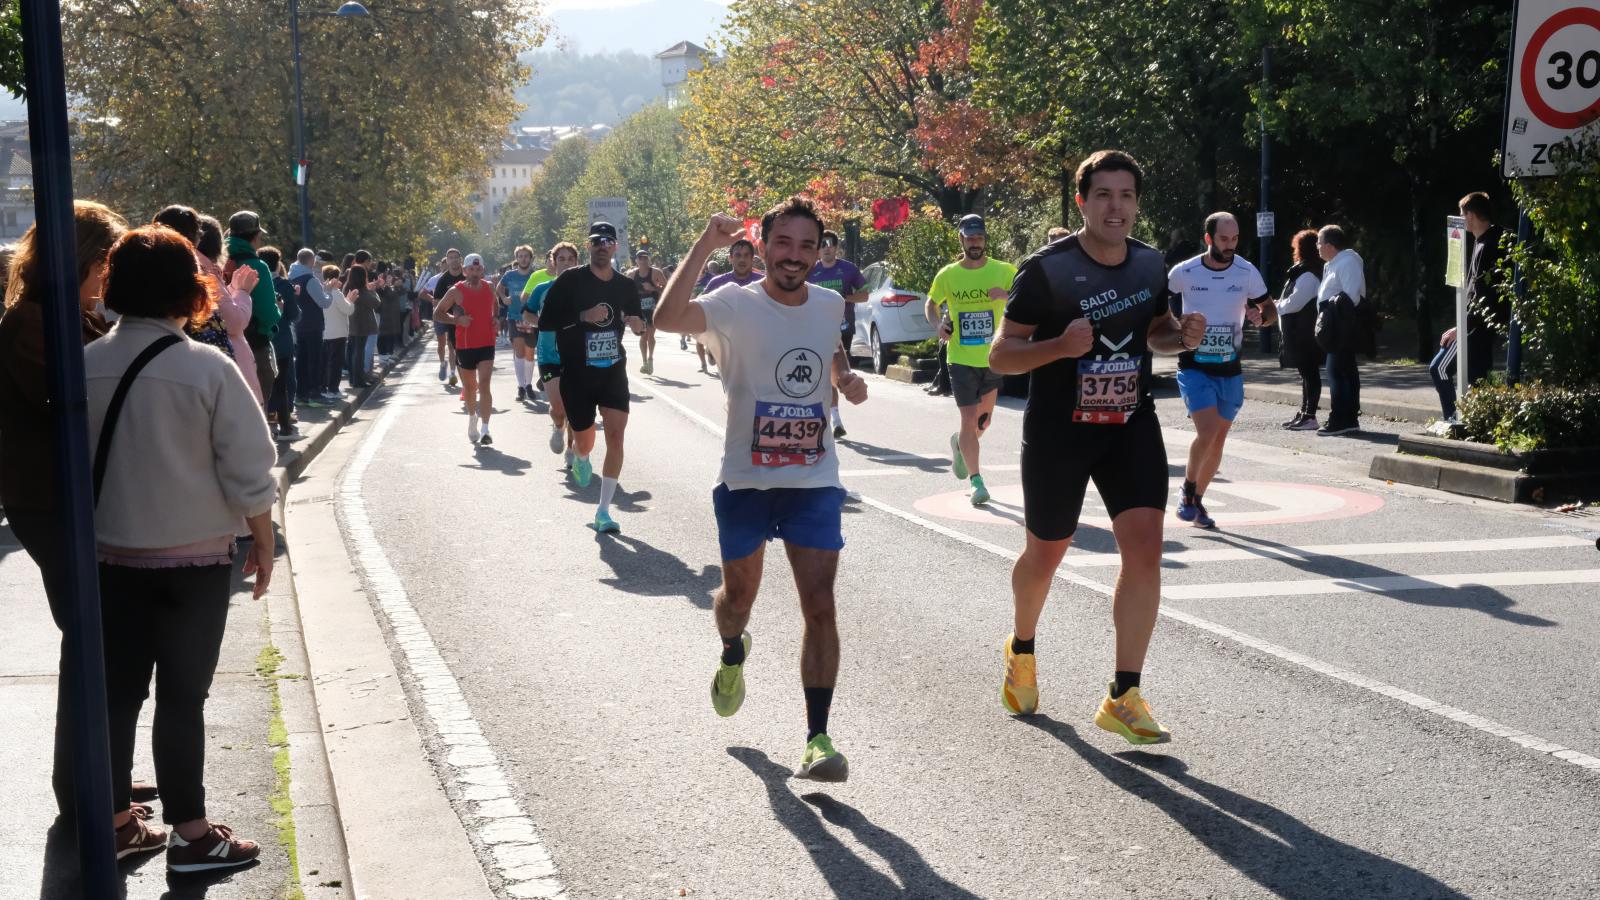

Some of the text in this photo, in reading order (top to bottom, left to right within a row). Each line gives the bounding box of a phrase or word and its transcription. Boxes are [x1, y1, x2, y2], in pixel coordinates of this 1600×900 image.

[1546, 50, 1600, 90] 30
[1080, 289, 1118, 311] SALTO
[1083, 288, 1152, 321] FOUNDATION
[962, 319, 992, 330] 6135
[590, 339, 617, 351] 6735
[1201, 335, 1232, 347] 6364
[786, 365, 812, 383] AR
[1083, 375, 1137, 396] 3756
[760, 420, 820, 440] 4439
